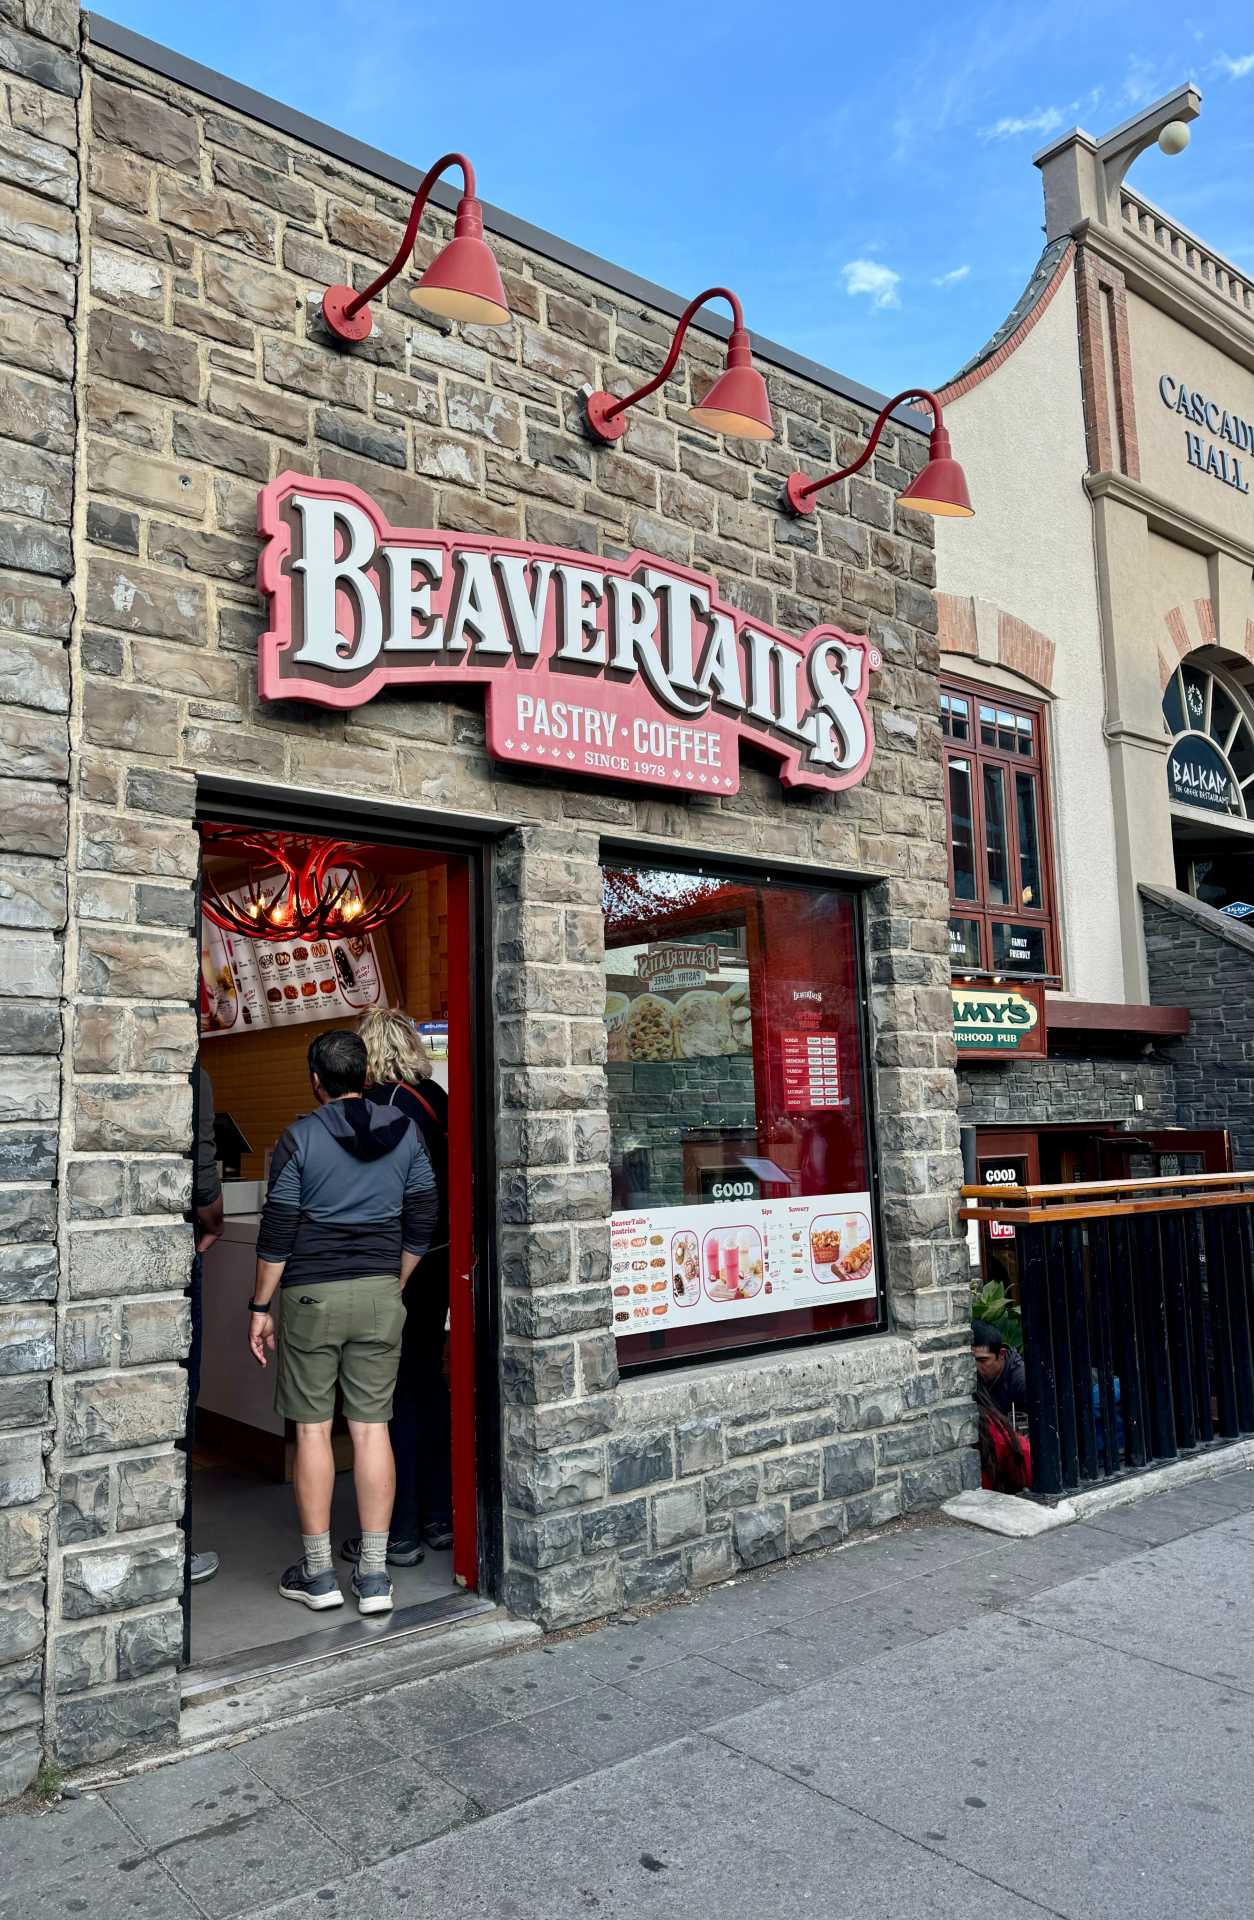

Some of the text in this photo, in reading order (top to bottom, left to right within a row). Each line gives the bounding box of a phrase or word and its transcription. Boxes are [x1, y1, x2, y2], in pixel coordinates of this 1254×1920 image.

[1184, 430, 1249, 495] HALL
[515, 694, 722, 768] PASTRY COFFEE
[584, 751, 667, 778] SINCE 1978
[1172, 757, 1227, 796] BALKAN
[1011, 937, 1027, 948] FAMILY
[1009, 948, 1031, 960] FRIENDLY
[997, 1033, 1017, 1043] PUB
[986, 1169, 1016, 1182] GOOD
[712, 1181, 754, 1198] GOOD
